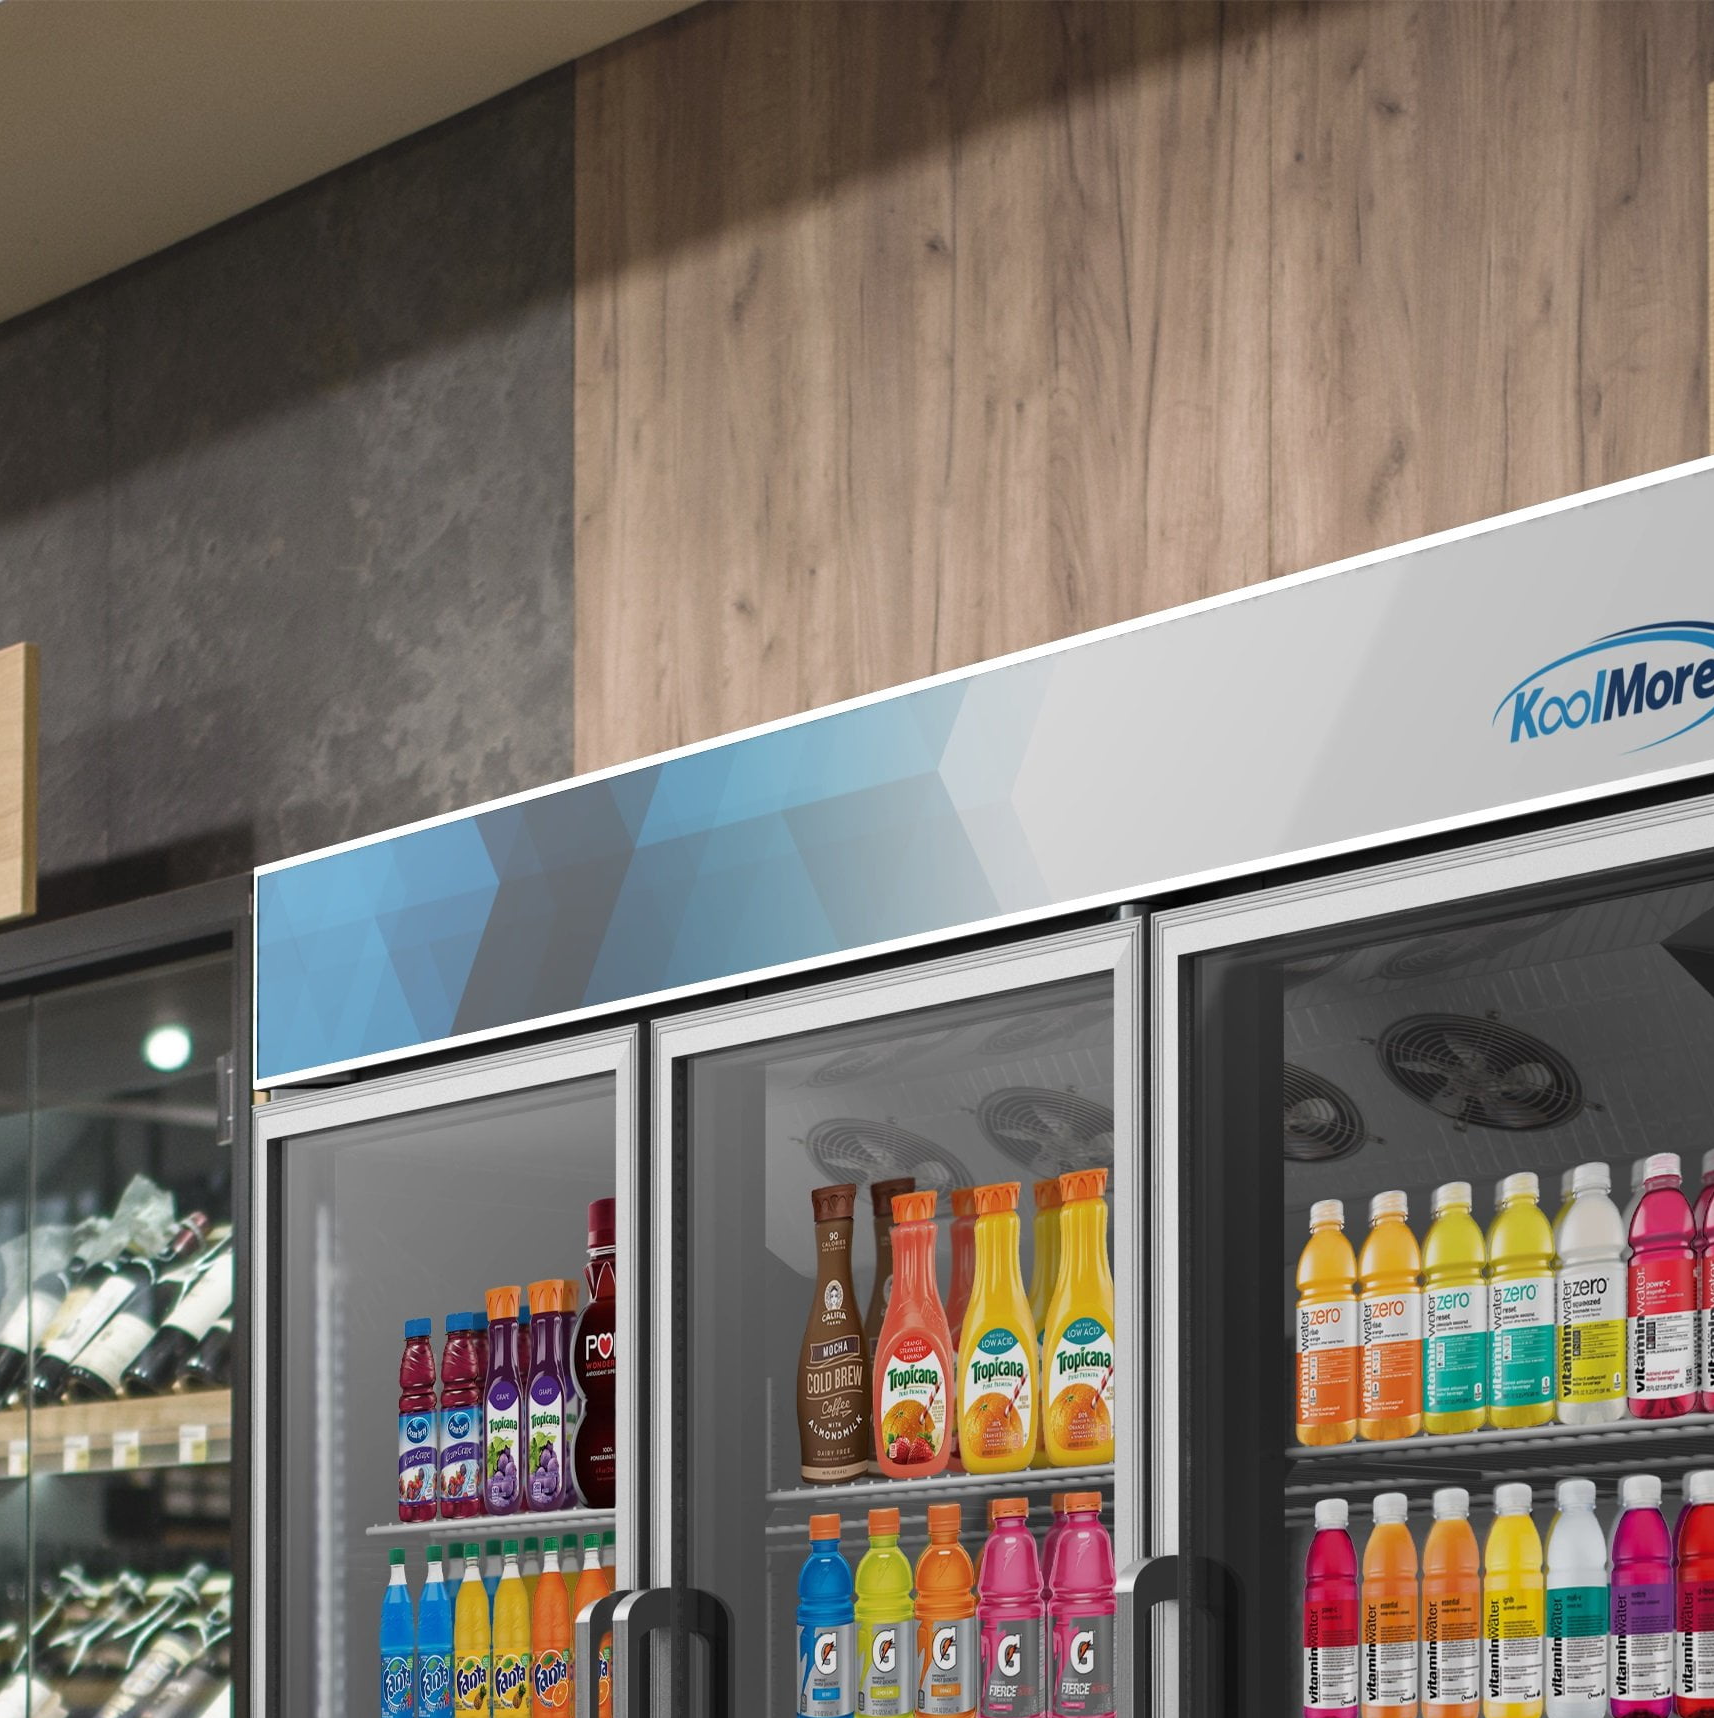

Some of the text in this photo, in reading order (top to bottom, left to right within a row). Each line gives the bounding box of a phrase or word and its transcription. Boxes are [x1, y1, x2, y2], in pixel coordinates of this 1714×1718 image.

[1502, 1284, 1537, 1301] zero
[1573, 1277, 1608, 1296] zero
[1372, 1300, 1405, 1318] zero
[1437, 1292, 1470, 1311] zero
[1309, 1307, 1341, 1325] zero
[1066, 1325, 1101, 1338] LOW ACID
[822, 1341, 849, 1357] MOCHA
[971, 1356, 1025, 1384] Tropicana
[1057, 1347, 1112, 1374] Tropicana
[806, 1365, 863, 1395] COLD BREW
[887, 1363, 939, 1391] Tropicana
[821, 1399, 852, 1420] Coffee
[489, 1418, 518, 1433] Tropicana
[531, 1413, 561, 1428] Tropicana
[808, 1415, 864, 1441] ALMONDMILK
[814, 1631, 837, 1675] G
[872, 1630, 896, 1673] G
[932, 1626, 957, 1671] G
[997, 1633, 1022, 1677] G
[1070, 1630, 1095, 1674] G
[989, 1684, 1018, 1698] FIERCE
[1061, 1682, 1092, 1696] FIERCE
